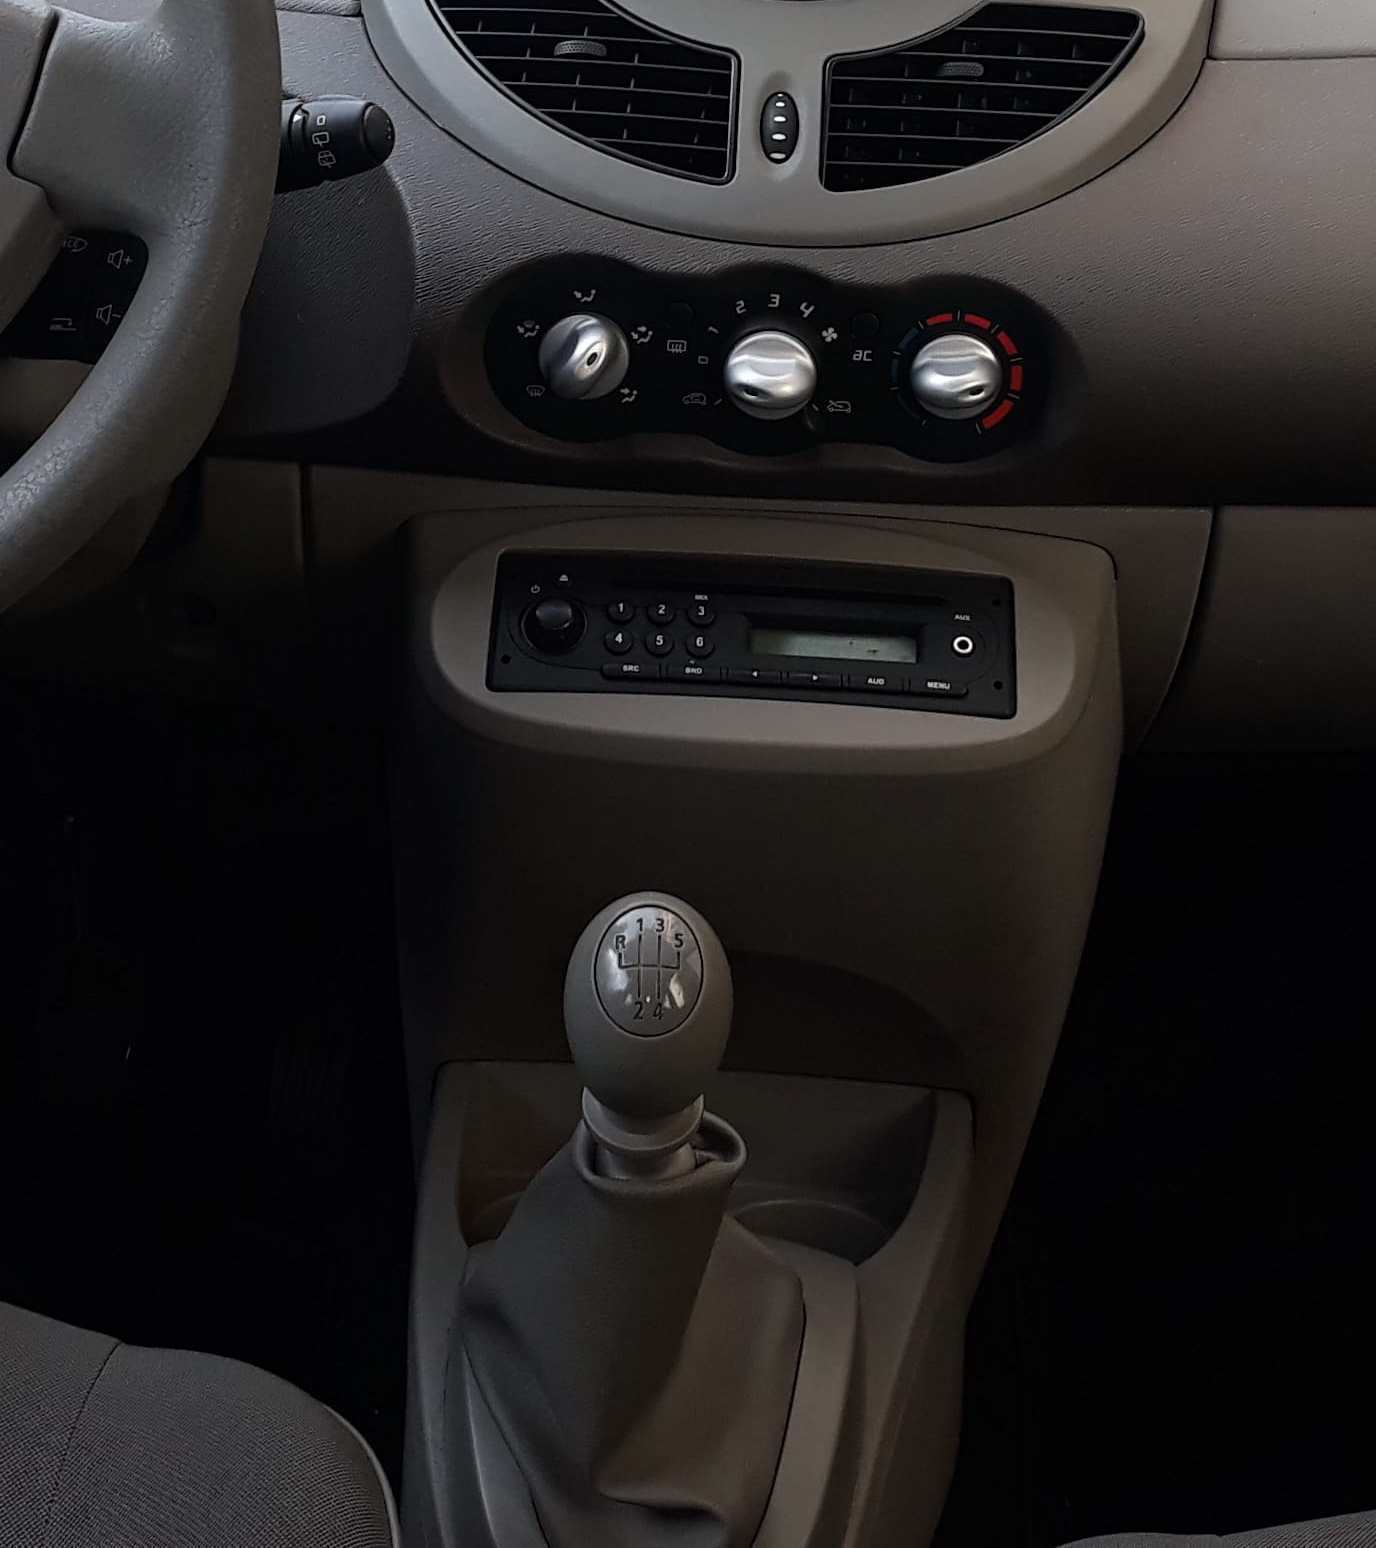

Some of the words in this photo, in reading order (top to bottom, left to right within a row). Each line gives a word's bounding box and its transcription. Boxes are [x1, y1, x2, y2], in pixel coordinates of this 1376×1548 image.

[768, 293, 781, 308] 3
[735, 300, 747, 315] 2
[799, 302, 815, 318] 4
[618, 602, 624, 613] 1
[658, 604, 666, 614] 2
[697, 606, 705, 616] 3
[954, 613, 971, 622] AUX
[614, 632, 623, 643] 4
[655, 635, 664, 645] 5
[695, 636, 704, 647] 6
[622, 664, 640, 673] SRC
[685, 667, 703, 675] BND
[867, 677, 886, 686] AUD
[927, 681, 951, 691] MENU
[636, 918, 644, 932] 1
[656, 918, 666, 932] 3
[614, 934, 626, 950] R
[674, 933, 684, 948] 5
[633, 1001, 643, 1020] 2
[652, 1002, 664, 1021] 4
